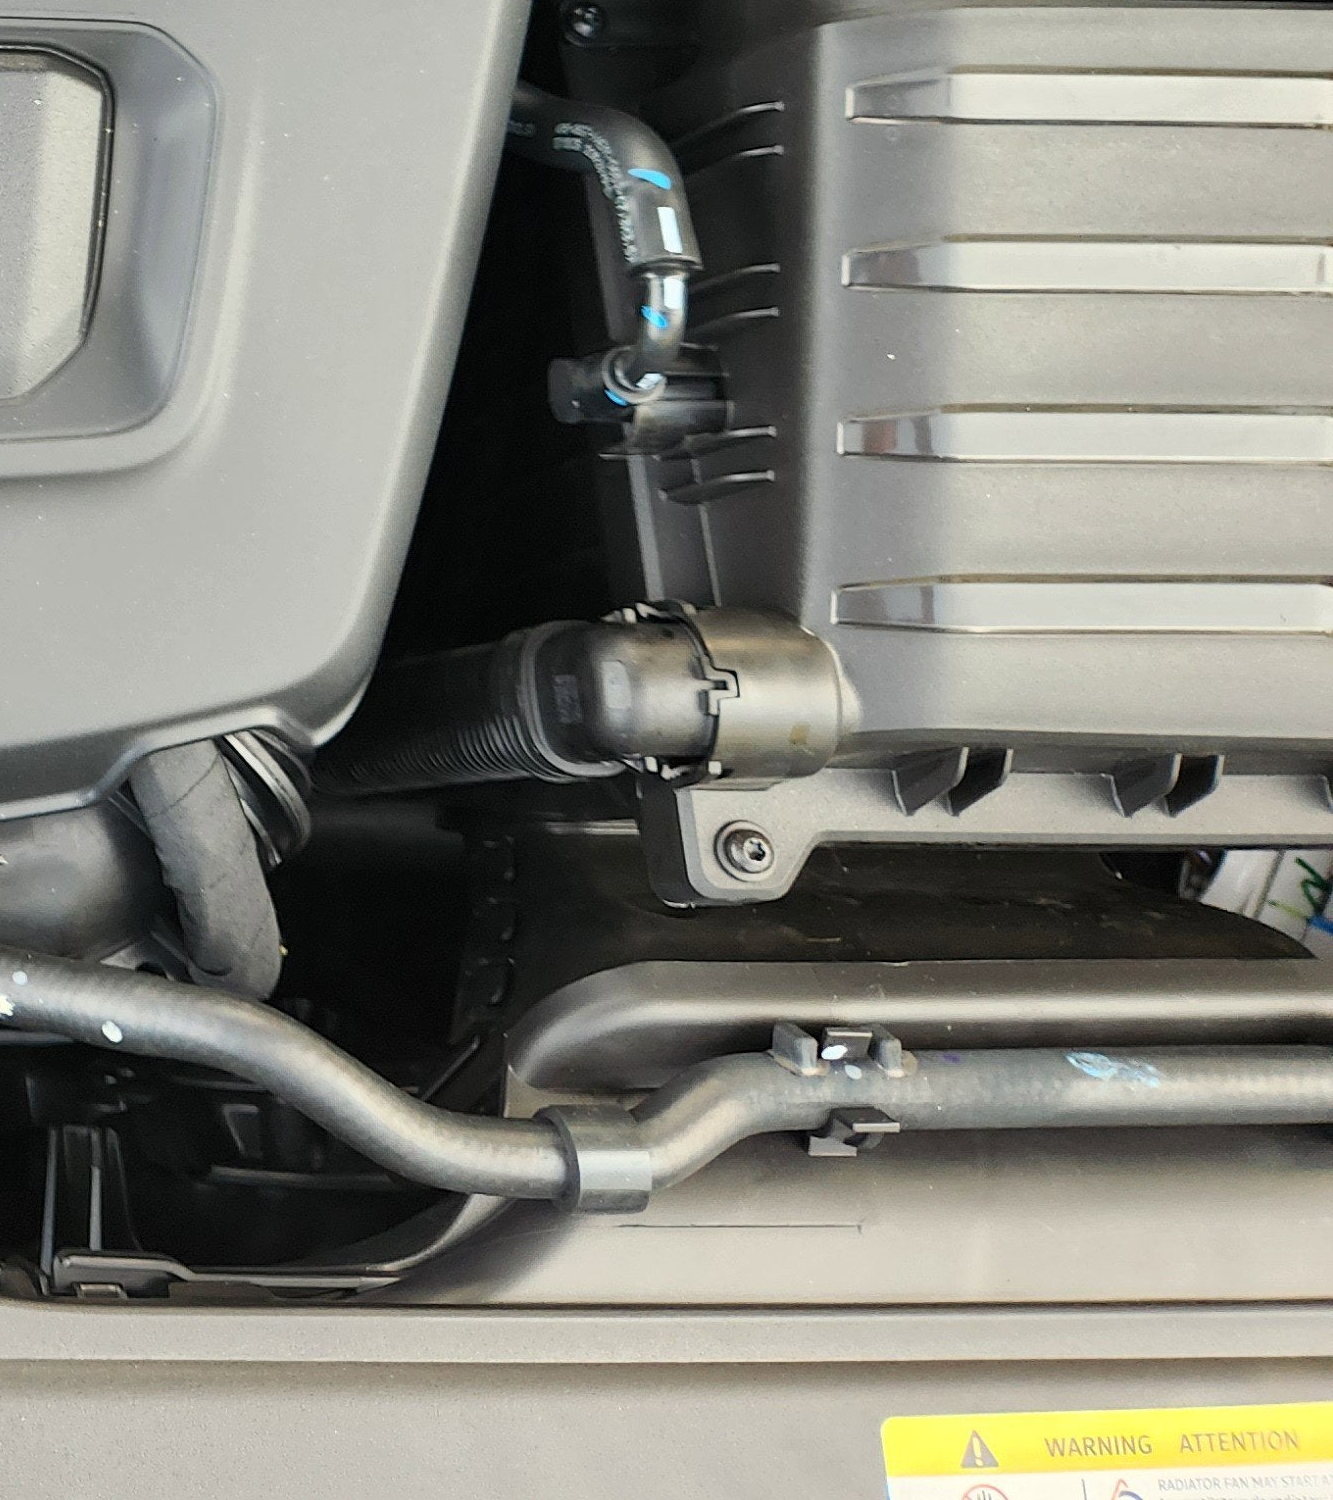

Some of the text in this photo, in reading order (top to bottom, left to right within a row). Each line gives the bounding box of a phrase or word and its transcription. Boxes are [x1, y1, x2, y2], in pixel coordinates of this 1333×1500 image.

[1044, 1430, 1300, 1458] WARNING ATTENTION
[1158, 1474, 1221, 1492] RADIATOR
[1223, 1473, 1248, 1491] FAN
[1251, 1472, 1279, 1489] MAY
[1281, 1472, 1319, 1488] START
